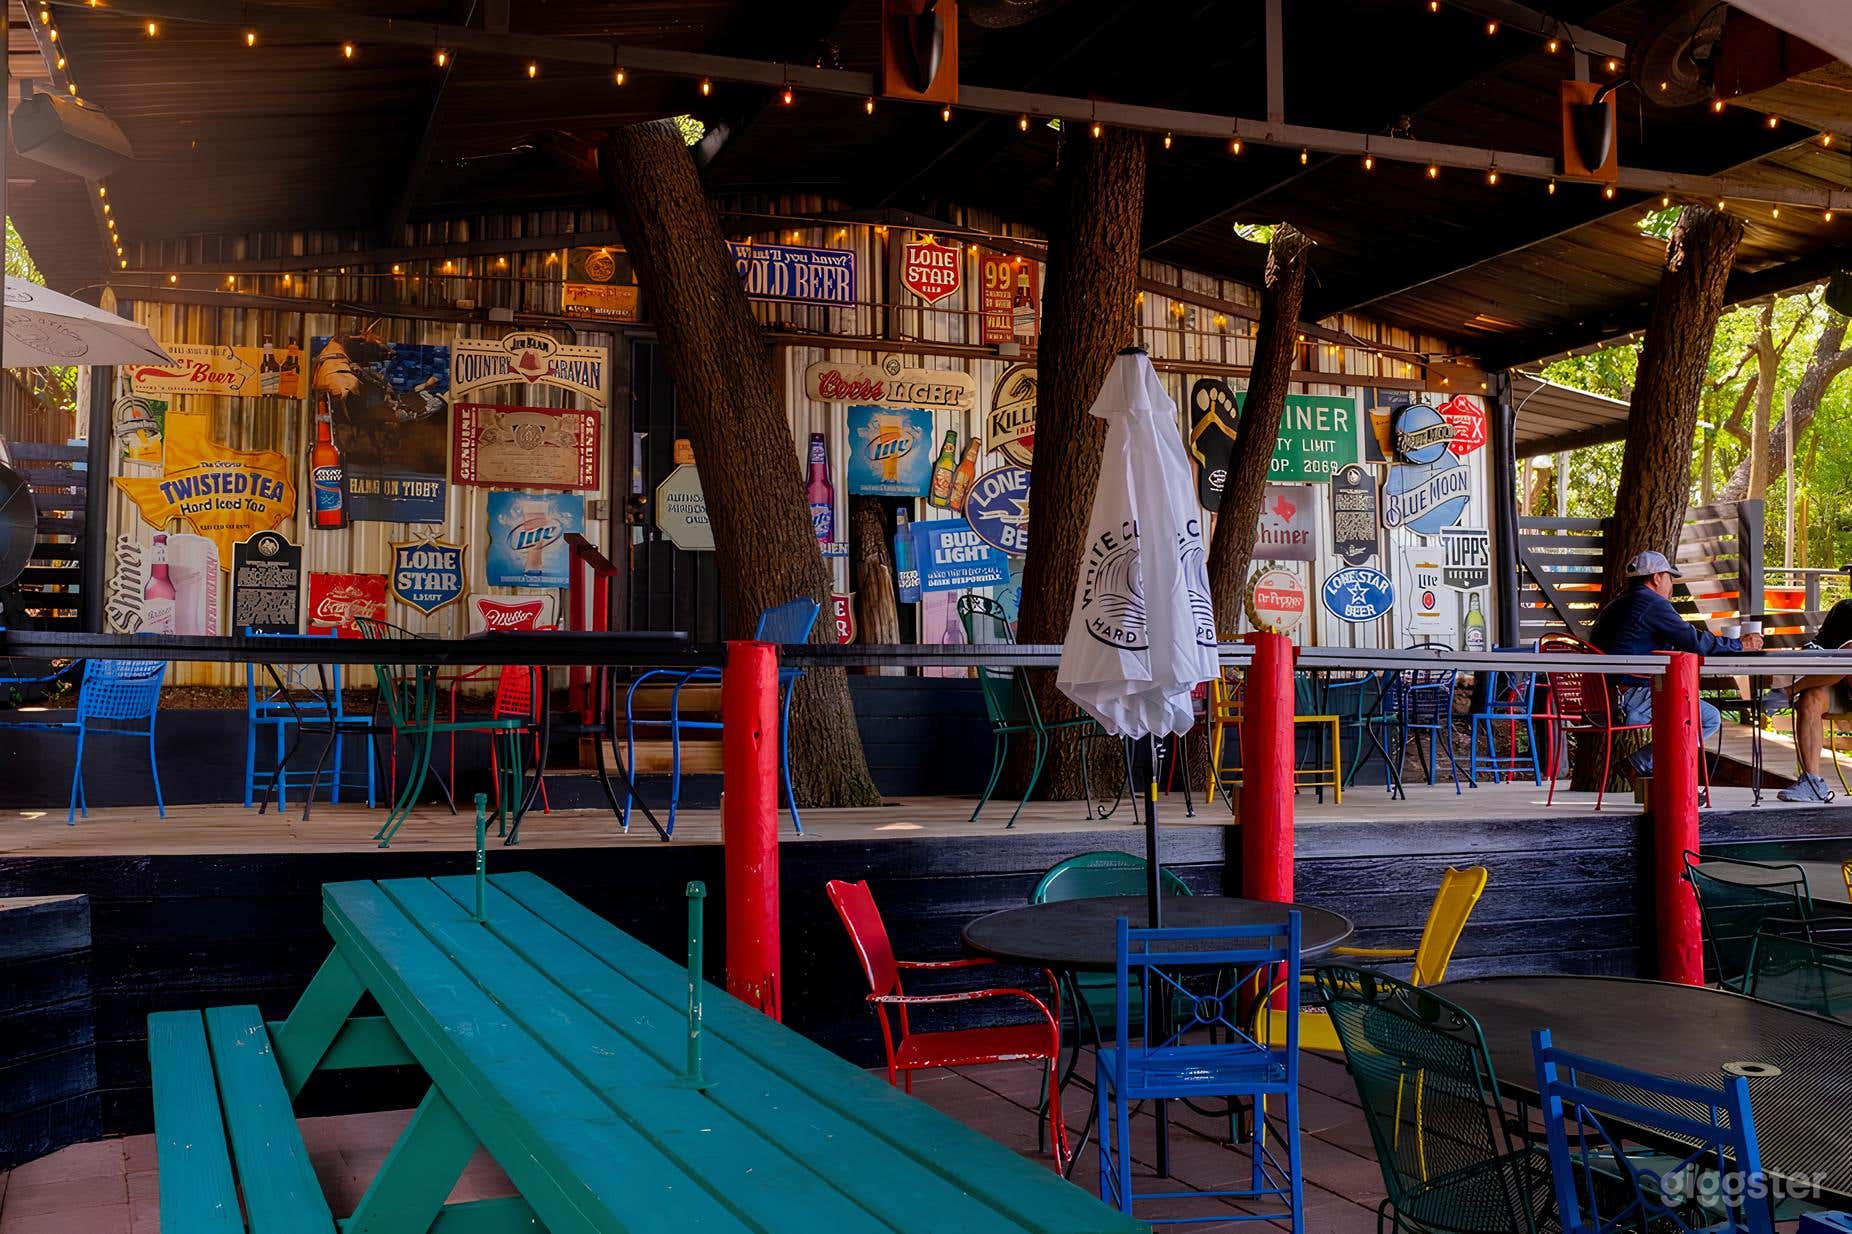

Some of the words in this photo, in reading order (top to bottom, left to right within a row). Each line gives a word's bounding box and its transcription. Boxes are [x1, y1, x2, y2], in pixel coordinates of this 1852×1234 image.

[909, 248, 955, 268] LONE
[793, 263, 850, 302] BEER
[908, 266, 956, 286] STAR
[984, 261, 1012, 290] 99
[456, 353, 513, 385] COUNTRY
[548, 358, 602, 392] CARAVAN
[885, 380, 965, 406] LIGHT
[1280, 404, 1349, 432] INER
[159, 472, 248, 505] TWISTED
[249, 472, 286, 503] TEA
[971, 470, 1027, 508] LONE
[1386, 489, 1427, 528] BLUE
[1429, 470, 1468, 505] MOON
[941, 531, 982, 549] BUD
[1256, 522, 1310, 545] hiner
[399, 550, 457, 571] LONE
[934, 544, 991, 564] LIGHT
[1441, 536, 1489, 566] TUPPS
[397, 571, 459, 592] STAR
[1358, 571, 1390, 595] STAR
[1092, 617, 1137, 643] HARD
